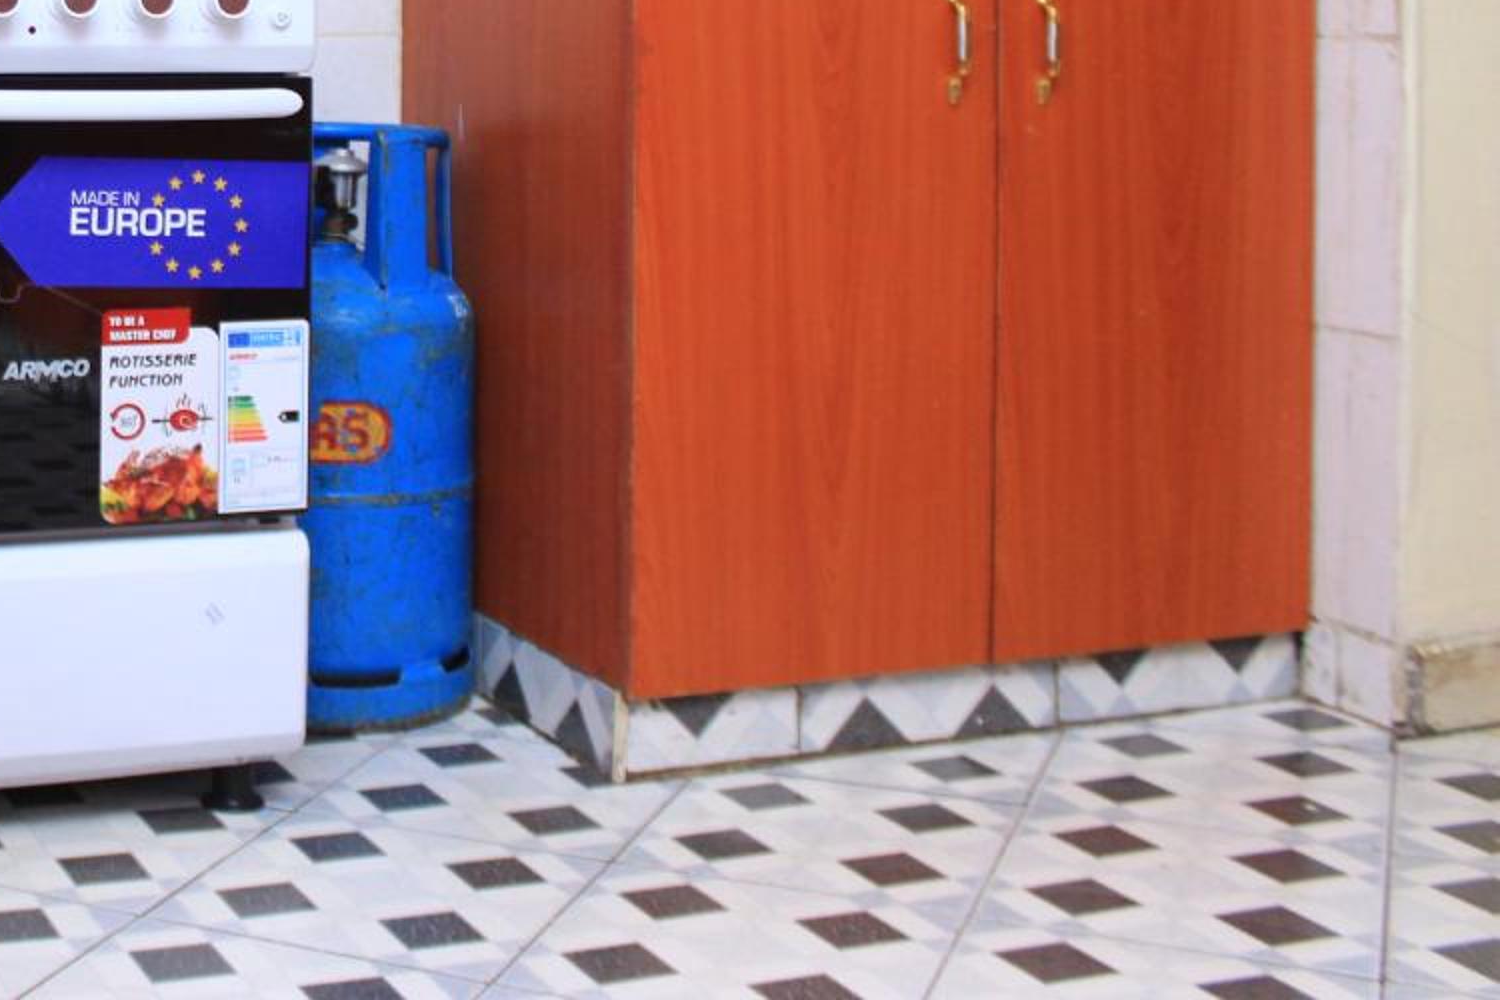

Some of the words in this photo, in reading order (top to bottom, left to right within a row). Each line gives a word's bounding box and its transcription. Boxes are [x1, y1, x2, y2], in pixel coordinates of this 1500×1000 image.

[71, 190, 119, 206] MADE
[123, 191, 140, 207] IN
[69, 207, 207, 237] EUROPE
[108, 315, 122, 327] TO
[137, 315, 145, 327] A
[109, 330, 151, 342] MASTER
[109, 353, 197, 369] ROTISSERIE
[3, 359, 91, 383] ARMCO
[109, 373, 183, 388] FUNCTION
[308, 413, 369, 452] AS
